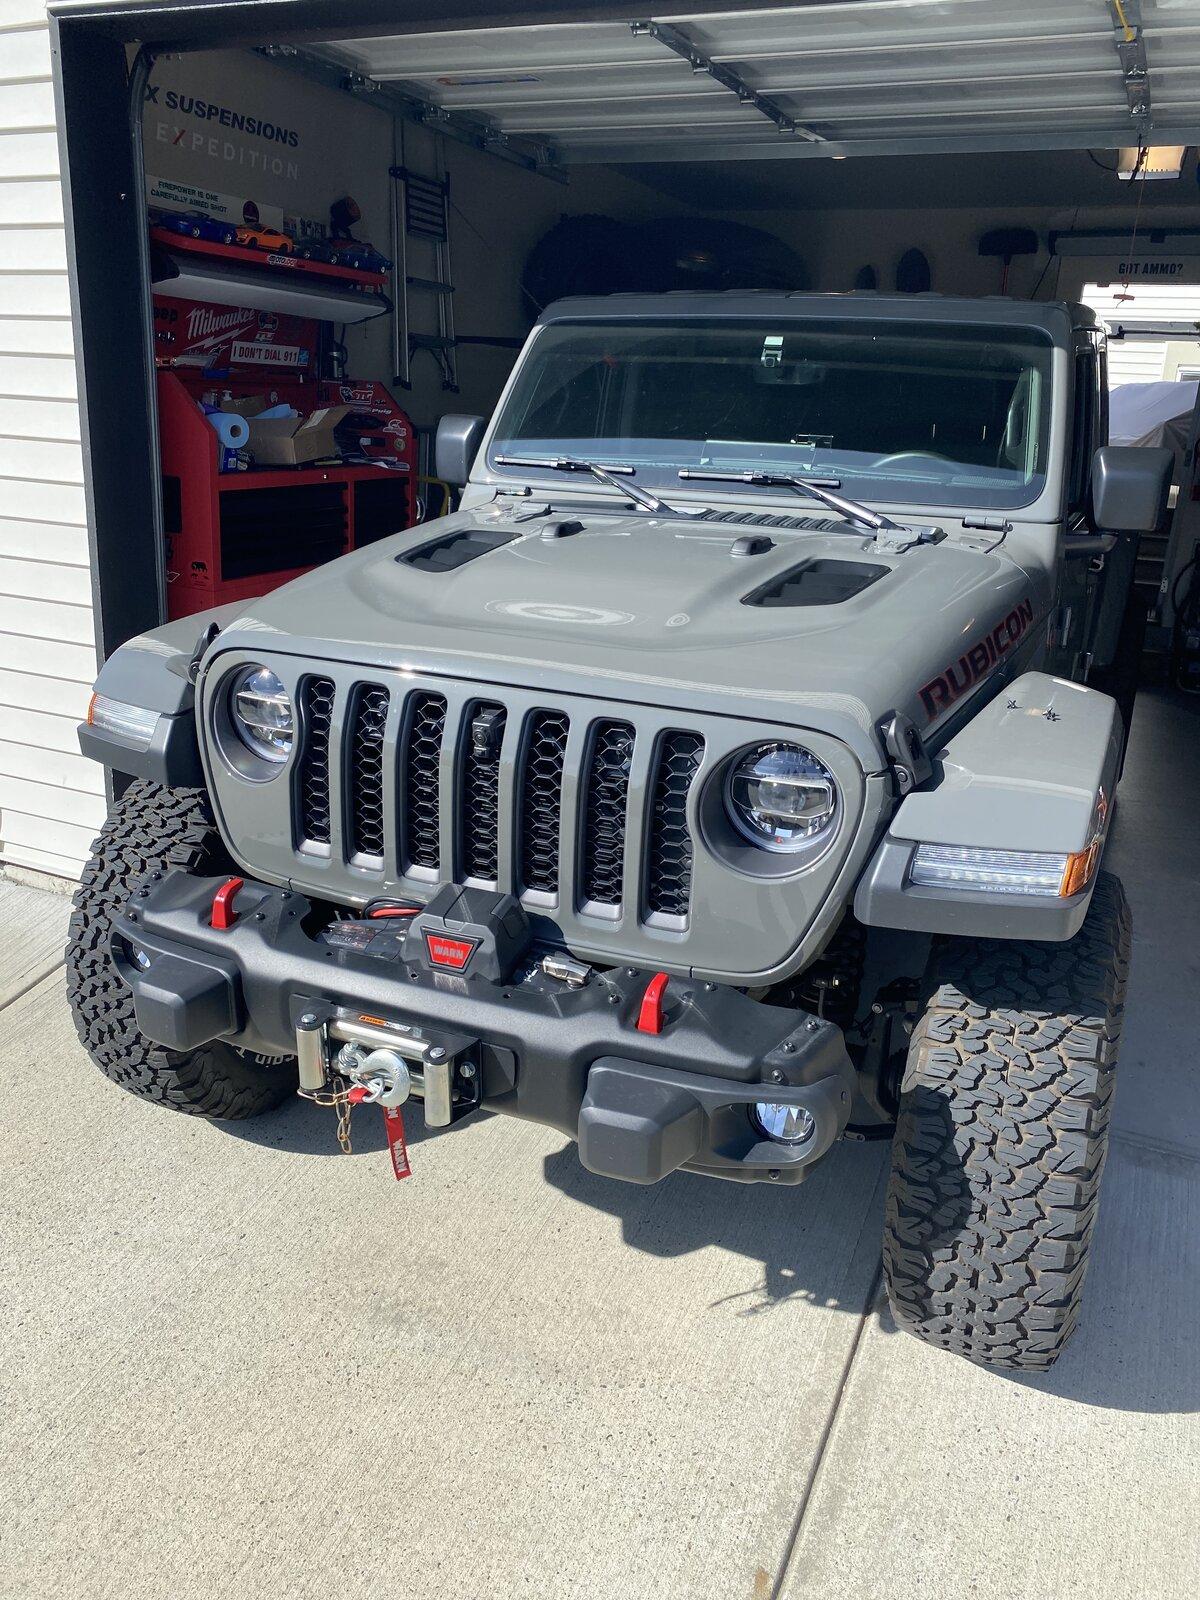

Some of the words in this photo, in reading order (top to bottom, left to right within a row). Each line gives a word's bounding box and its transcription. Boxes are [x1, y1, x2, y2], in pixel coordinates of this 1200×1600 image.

[165, 90, 299, 147] SUSPENSIONS
[156, 121, 299, 180] EXPEDITION
[150, 189, 188, 204] CAREFULLY
[189, 198, 209, 210] AIMED
[158, 181, 196, 196] FIREPOWER
[197, 190, 204, 198] IS
[205, 192, 219, 202] ONE
[1118, 263, 1140, 274] GOT
[1142, 263, 1184, 274] AMMO?
[186, 308, 256, 341] Milwaukee
[233, 346, 237, 356] I
[239, 346, 262, 359] DON'T
[264, 349, 282, 361] DIAL
[283, 350, 297, 362] 911
[917, 597, 1035, 724] RUBICON
[433, 944, 464, 959] WARN
[393, 1138, 408, 1173] WARN
